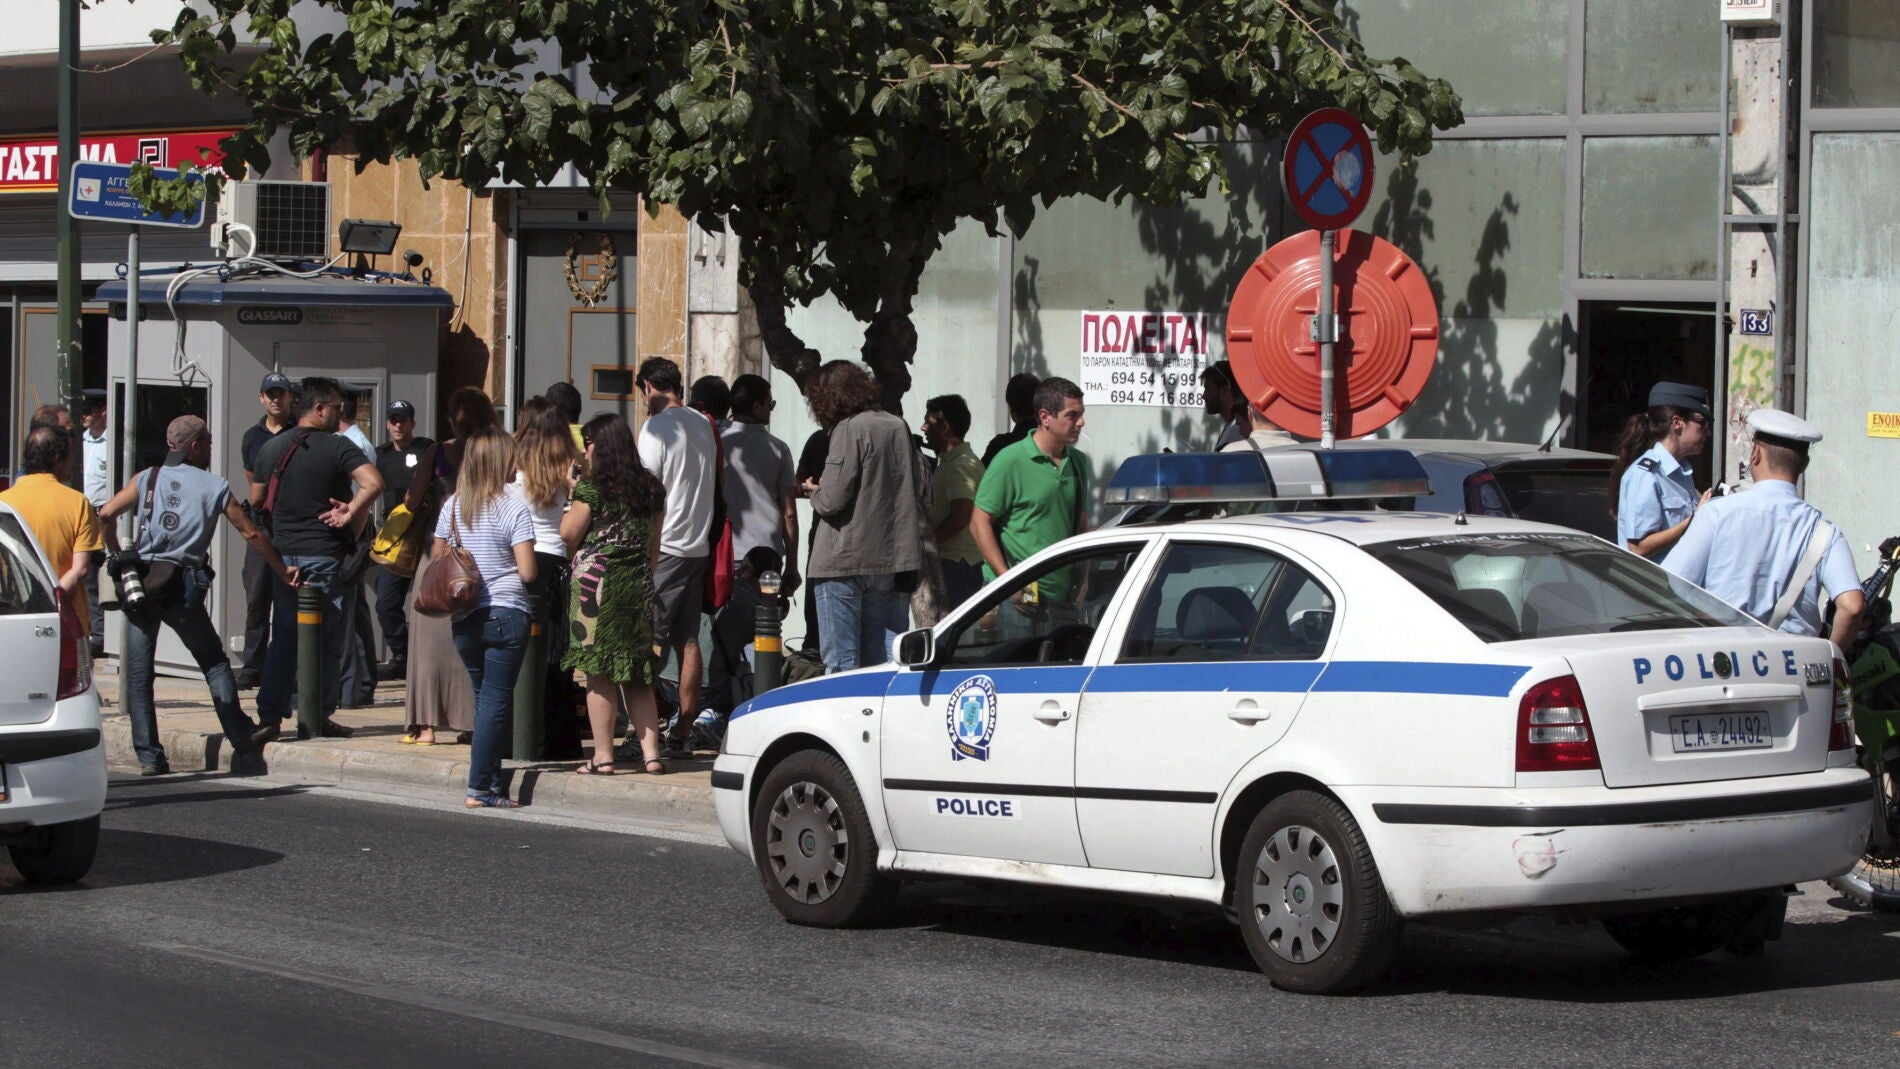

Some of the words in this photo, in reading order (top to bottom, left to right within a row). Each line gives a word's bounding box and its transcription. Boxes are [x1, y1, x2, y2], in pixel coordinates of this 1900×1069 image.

[1742, 312, 1768, 332] 133
[1083, 314, 1208, 355] ΠΩΛΕΙΤΑΙ
[1091, 356, 1111, 367] ΠΑΡΟΝ
[1111, 356, 1145, 368] ΚΑΤΑΣΤΗΜΑ
[1111, 371, 1135, 385] 694
[1140, 371, 1155, 386] 54
[1160, 372, 1177, 386] 15
[1110, 390, 1134, 403] 694
[1138, 390, 1154, 404] 47
[1160, 391, 1175, 405] 16
[1179, 391, 1204, 406] 888
[1633, 650, 1798, 684] POLICE
[1719, 716, 1764, 745] 24492
[936, 798, 1013, 817] POLICE
